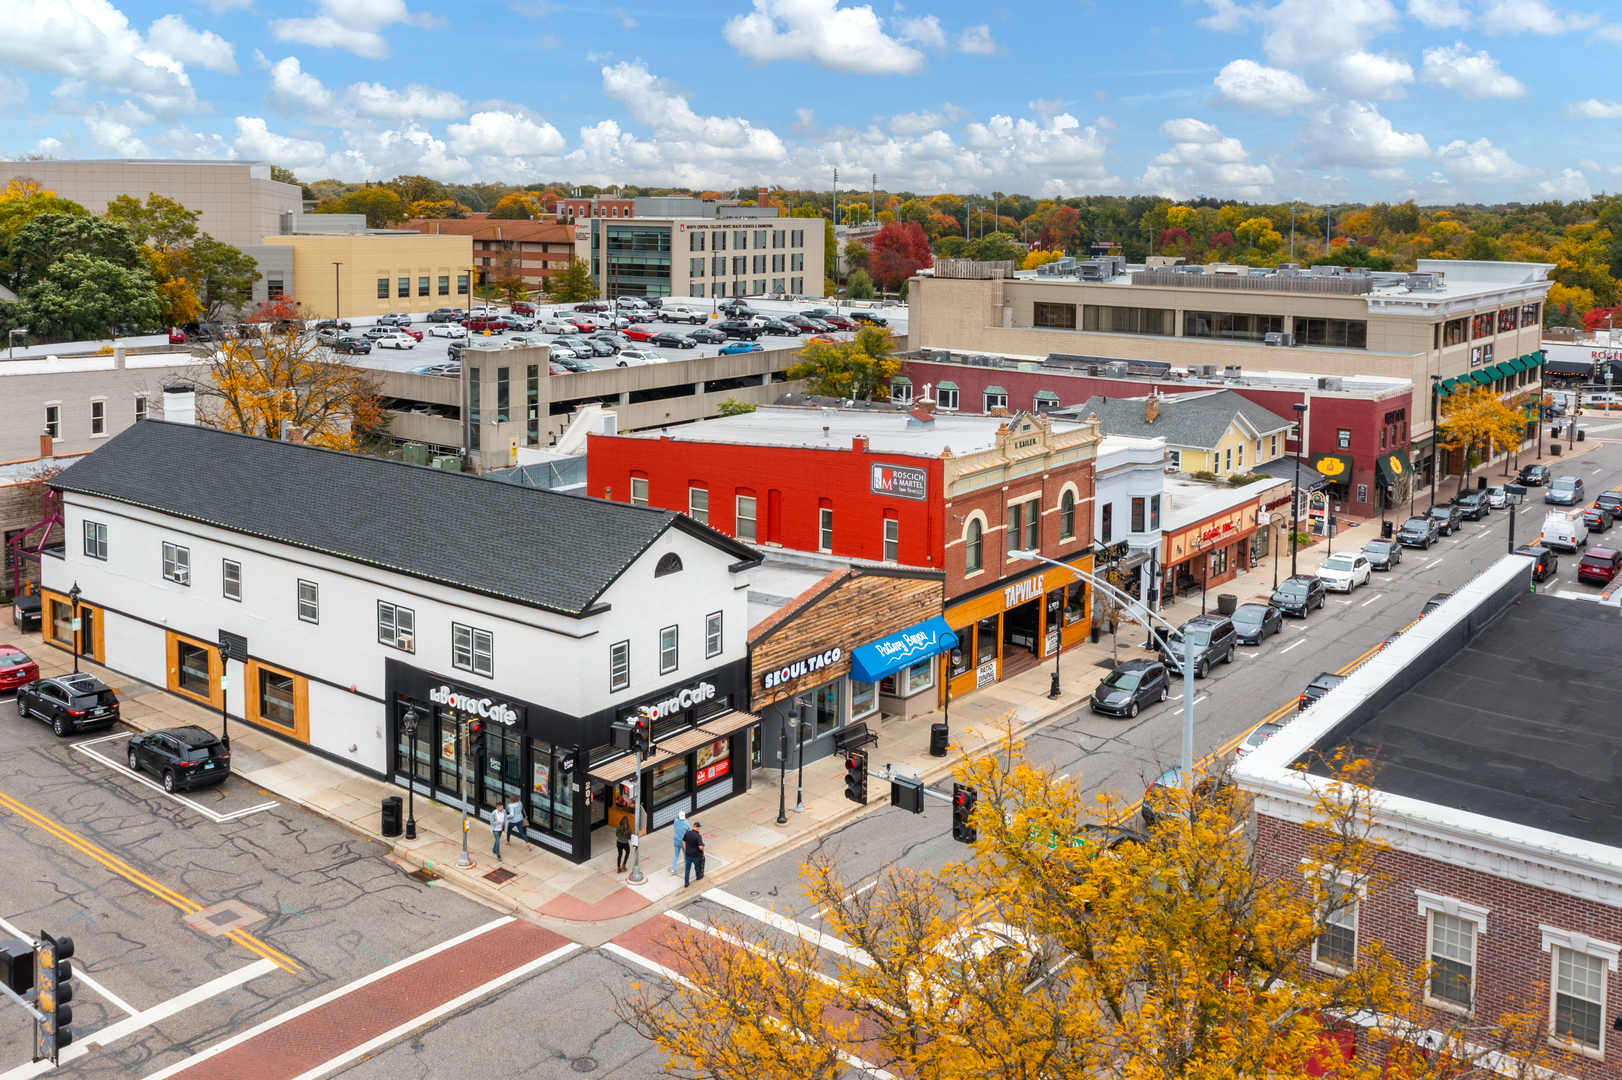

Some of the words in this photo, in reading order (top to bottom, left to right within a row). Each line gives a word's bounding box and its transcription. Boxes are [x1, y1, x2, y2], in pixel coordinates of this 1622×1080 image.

[893, 470, 924, 481] ROSCICH
[899, 479, 924, 489] MARTEL
[1005, 575, 1044, 609] TAPVILLE
[765, 660, 808, 689] SEOUL
[807, 647, 841, 672] TACO
[980, 663, 993, 674] PATIO
[978, 670, 994, 683] DINING
